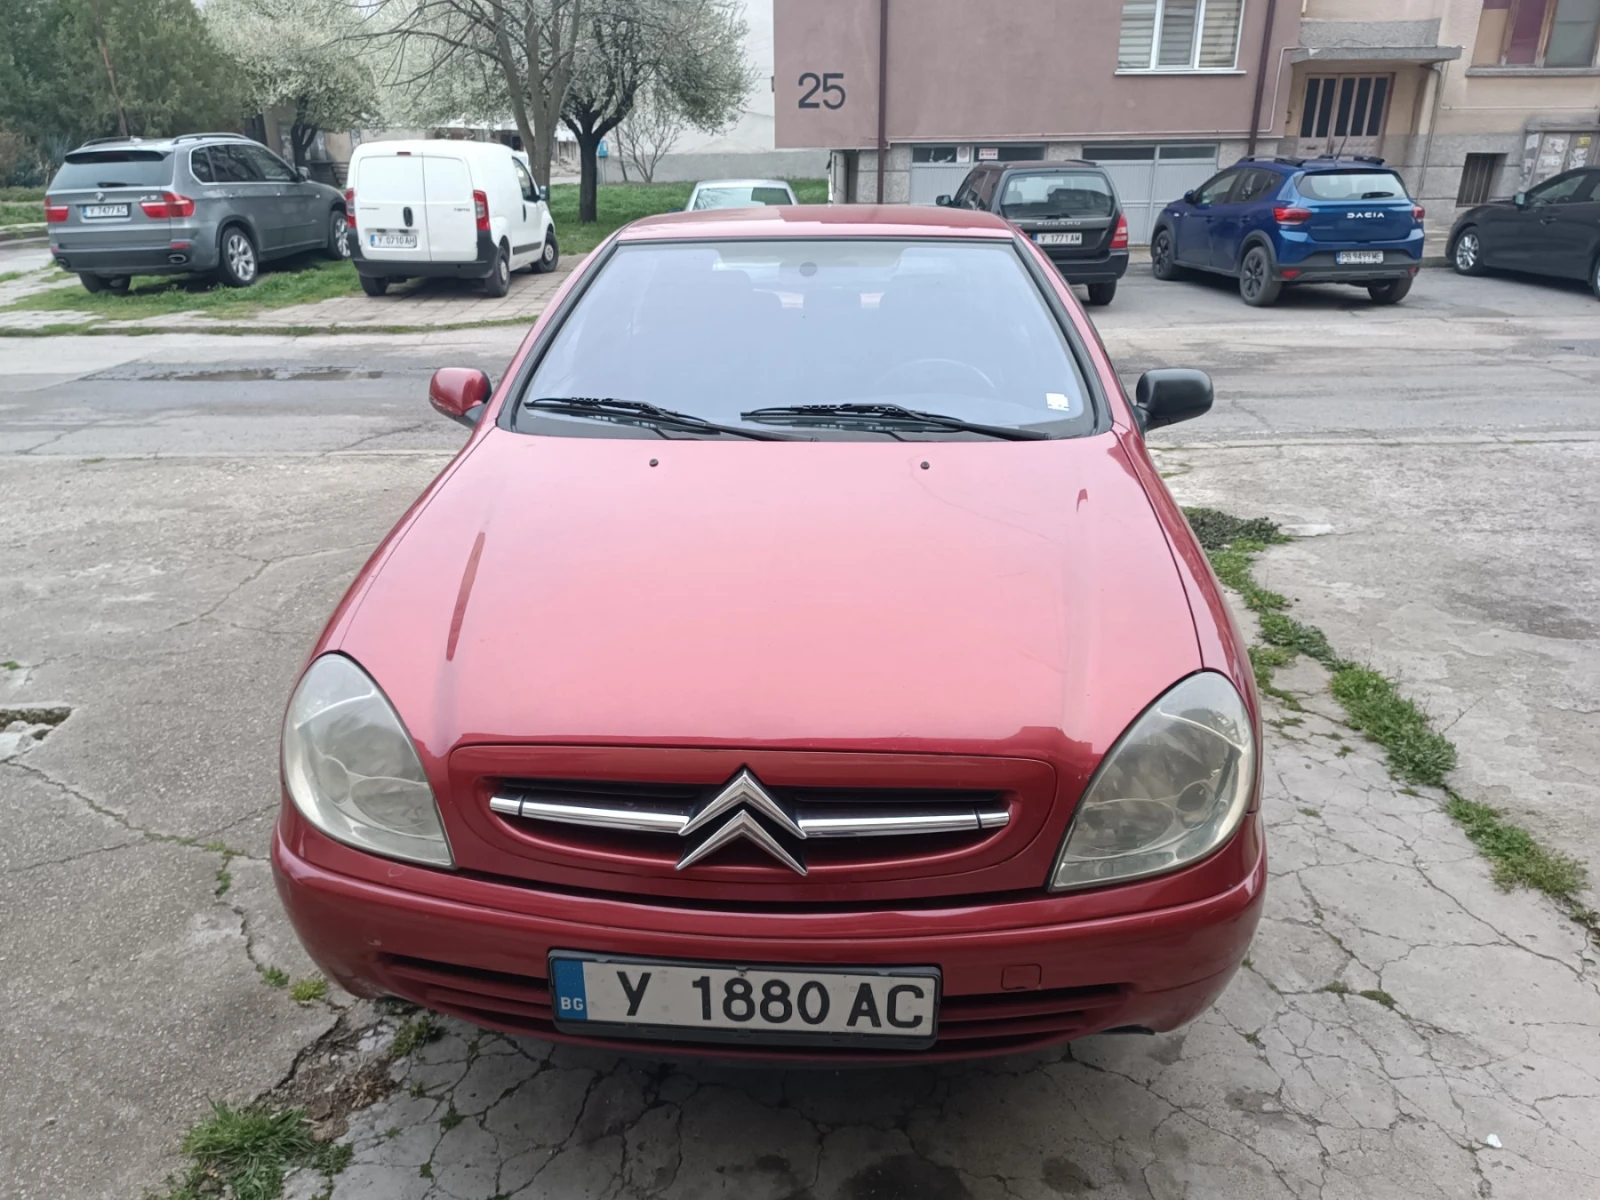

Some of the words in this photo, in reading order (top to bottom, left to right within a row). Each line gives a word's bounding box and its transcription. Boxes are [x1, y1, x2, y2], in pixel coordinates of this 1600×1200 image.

[798, 72, 846, 110] 25
[386, 235, 403, 245] 0710
[405, 235, 415, 244] AH
[1051, 234, 1068, 243] 1771
[560, 996, 584, 1011] BG
[616, 970, 652, 1017] Y
[691, 975, 830, 1025] 1880
[846, 982, 924, 1029] AC
